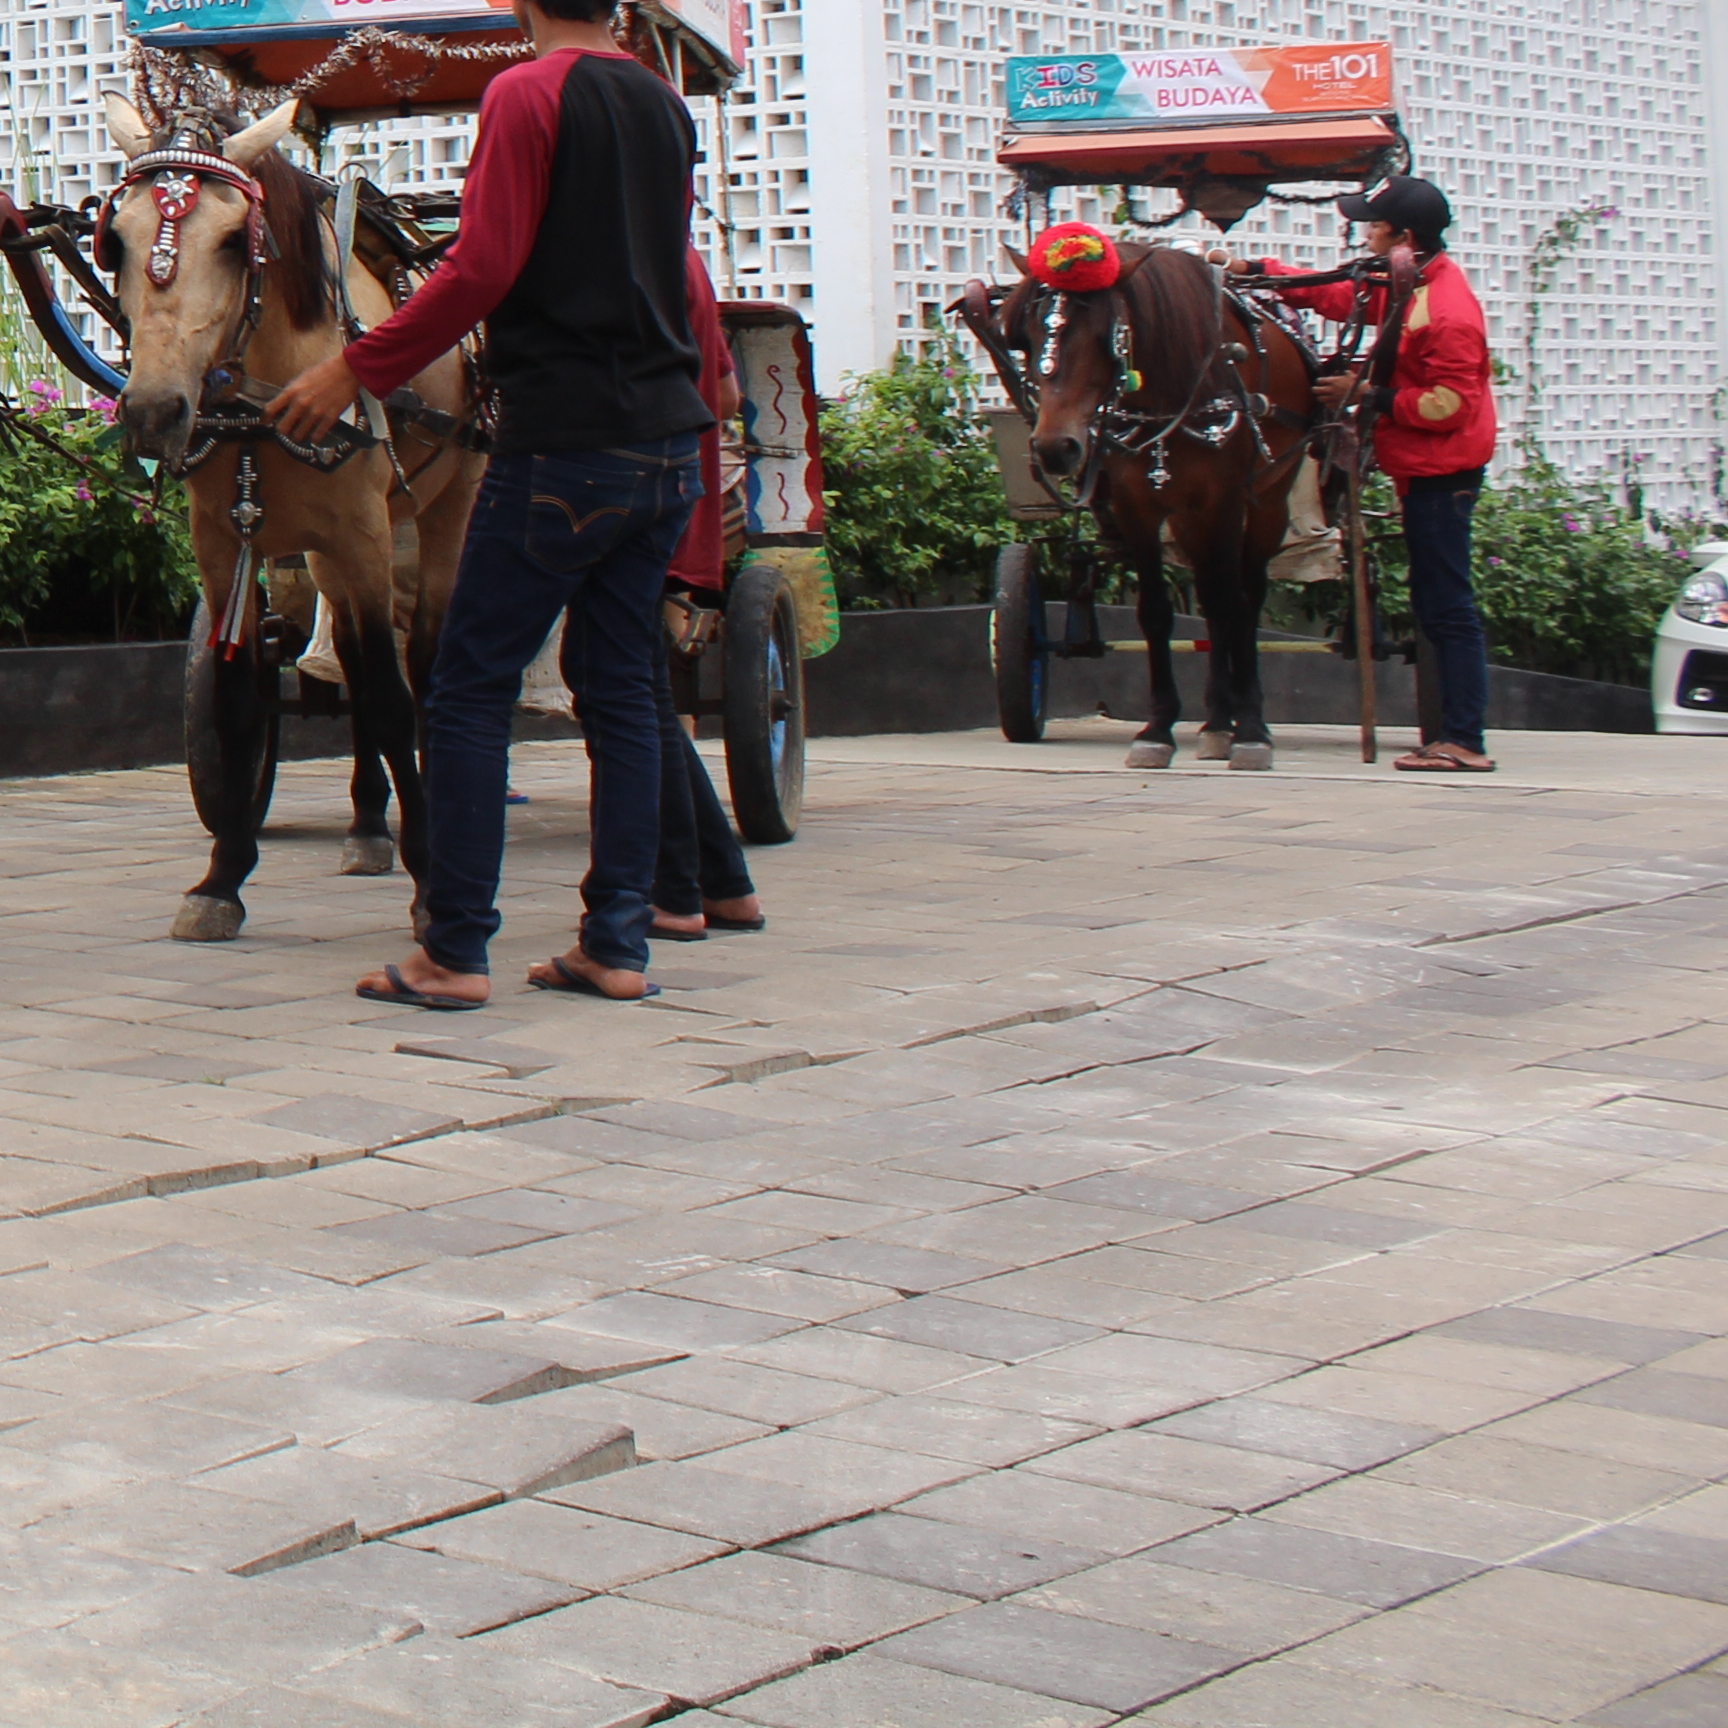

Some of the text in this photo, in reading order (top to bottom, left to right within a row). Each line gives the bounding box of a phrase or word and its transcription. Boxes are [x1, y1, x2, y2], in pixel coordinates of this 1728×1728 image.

[1016, 63, 1098, 92] KIDS
[1131, 58, 1223, 79] WISATA
[1020, 88, 1100, 109] Activity
[1157, 86, 1257, 108] BUDAYA
